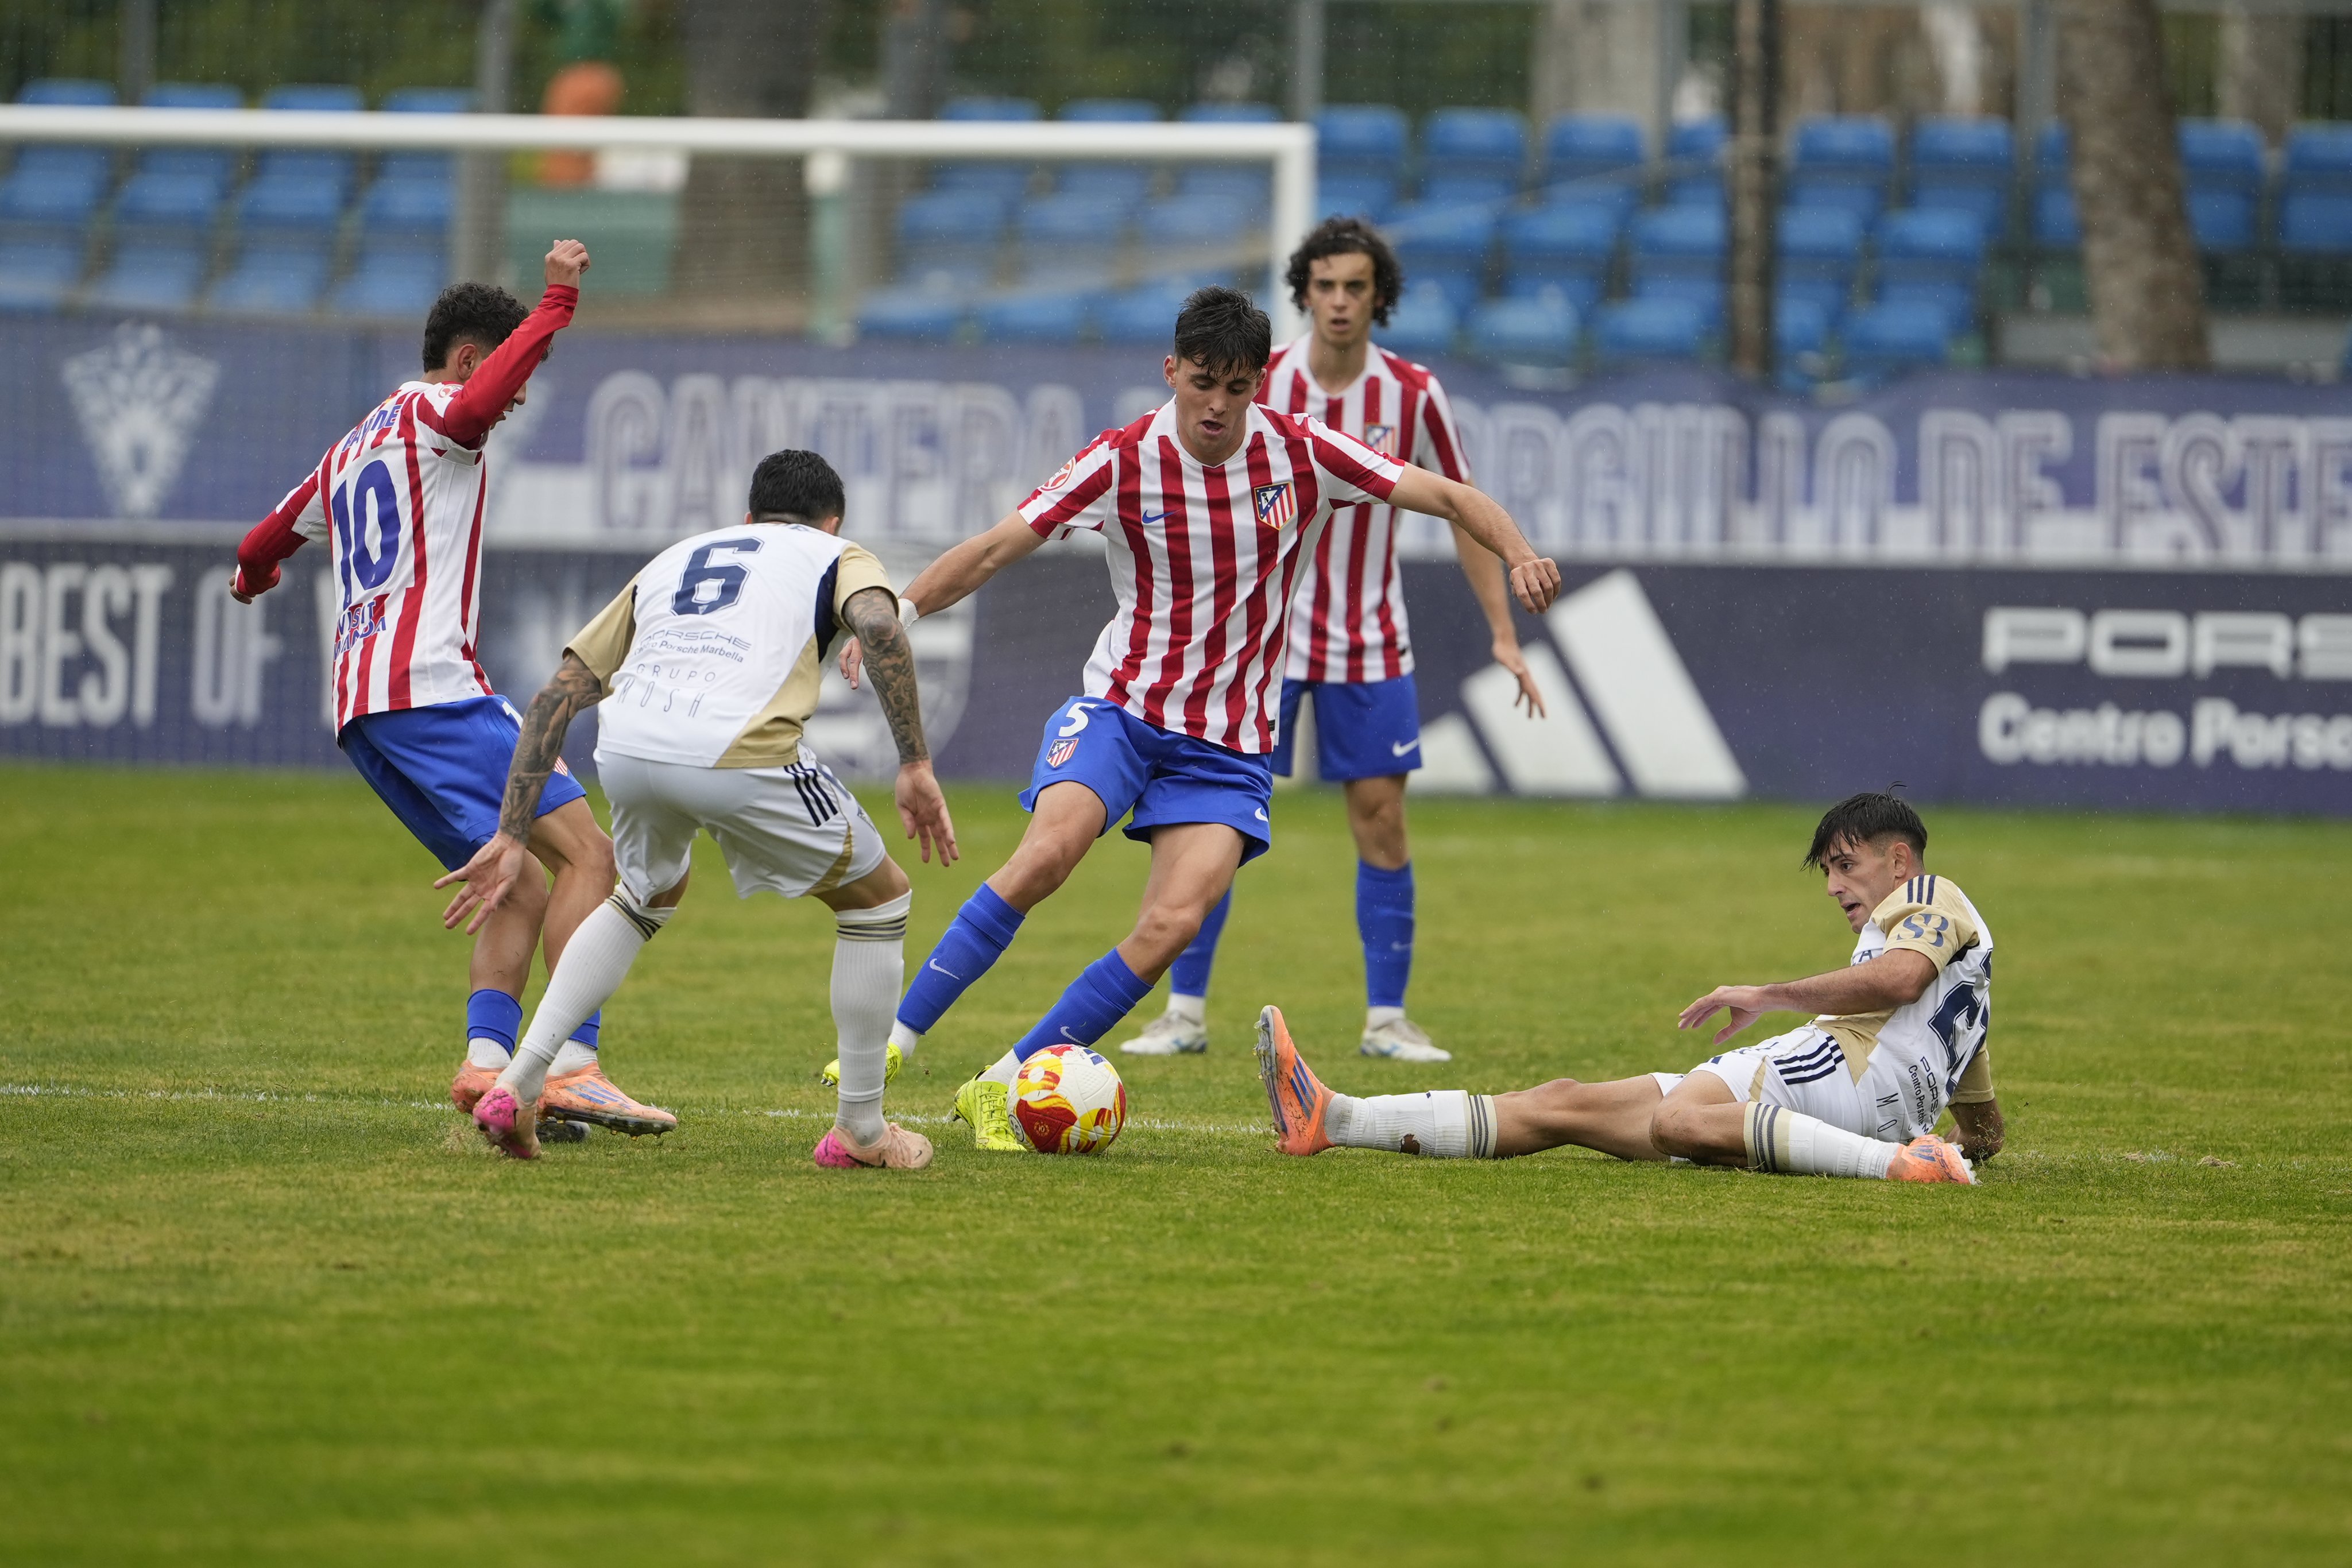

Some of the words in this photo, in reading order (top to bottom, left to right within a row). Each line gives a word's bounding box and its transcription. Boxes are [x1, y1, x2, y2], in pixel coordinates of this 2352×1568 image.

[585, 370, 1084, 534] CANTERA
[1918, 408, 2074, 556] DE
[332, 459, 401, 612] 10
[671, 536, 764, 617] 6
[338, 600, 376, 635] VISIT
[0, 560, 173, 730] BEST
[192, 564, 281, 729] OF
[659, 640, 699, 655] Porsche
[700, 644, 744, 663] Marbella
[636, 663, 716, 683] GRUPO
[617, 678, 705, 718] MOSH
[1058, 702, 1101, 738] 5
[1976, 690, 2188, 768] Centro
[1908, 1064, 1922, 1097] Centro
[1914, 1093, 1925, 1126] Porsche
